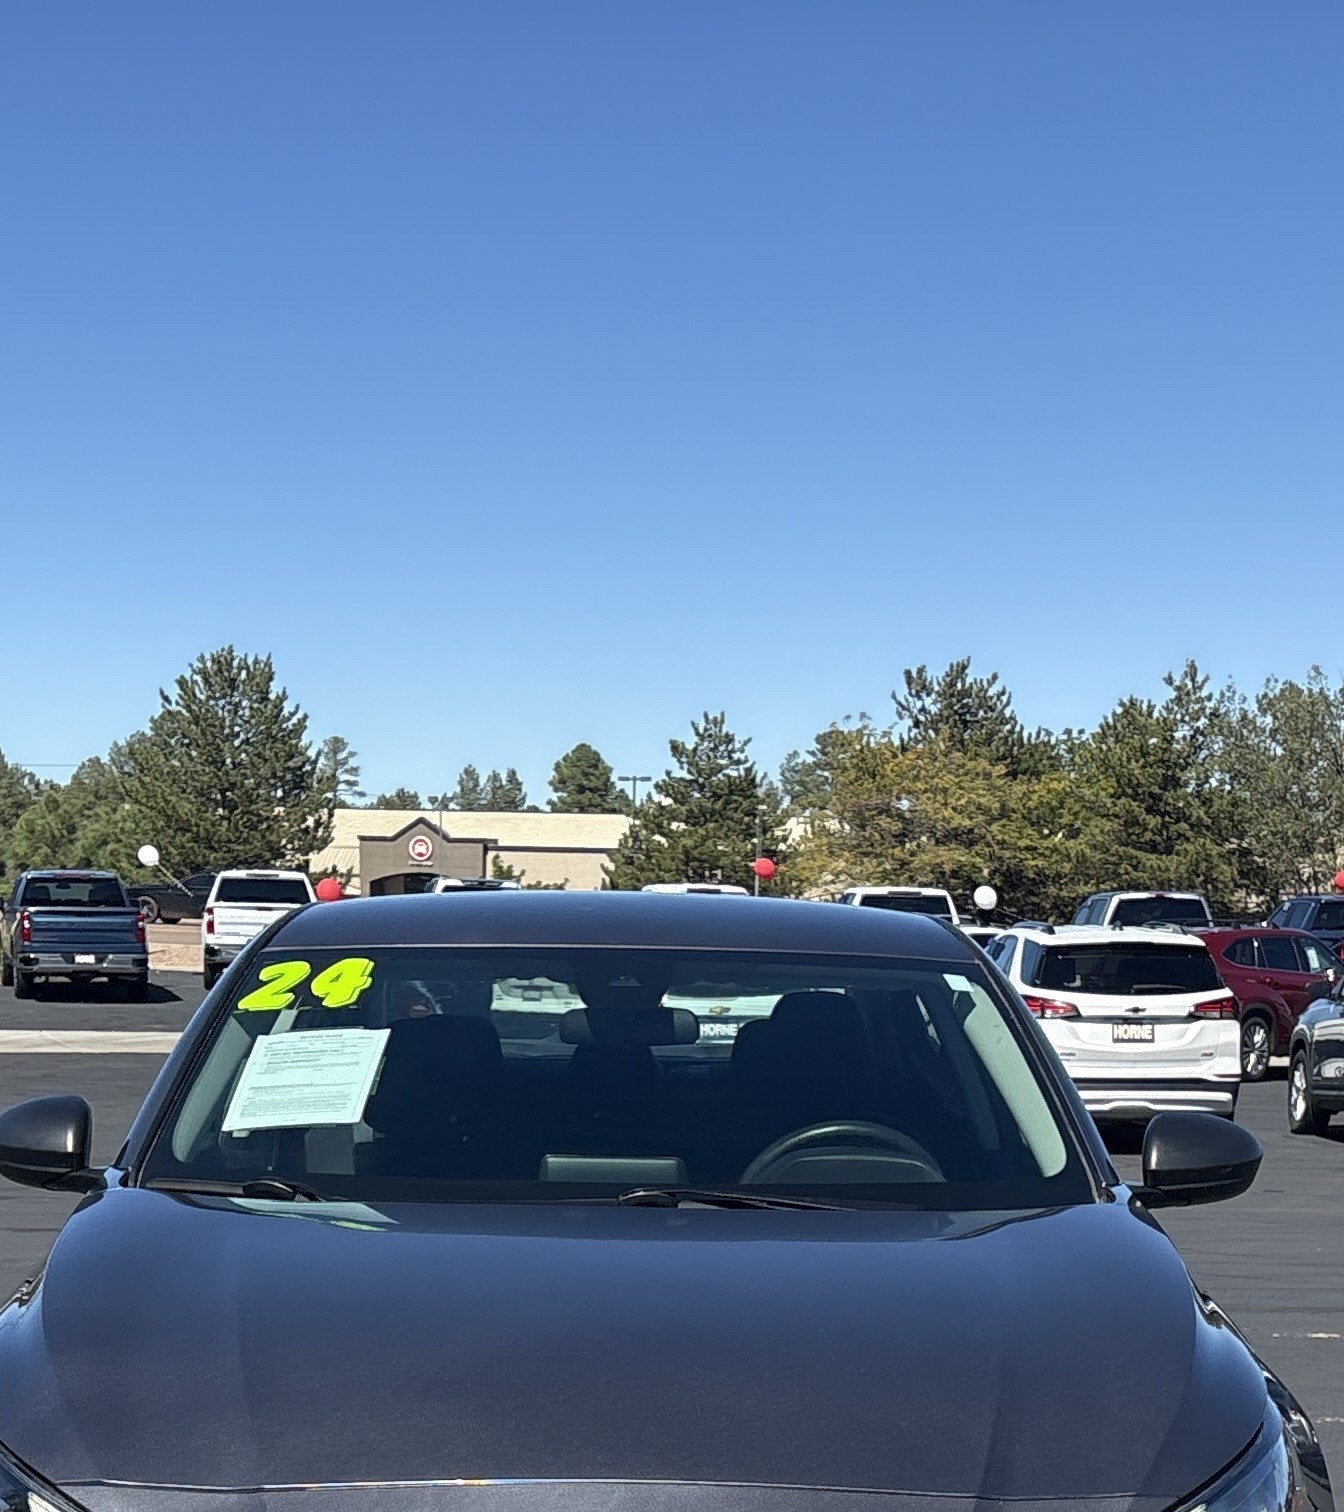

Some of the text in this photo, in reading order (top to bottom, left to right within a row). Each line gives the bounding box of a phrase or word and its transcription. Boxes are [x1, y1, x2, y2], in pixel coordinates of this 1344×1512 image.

[237, 957, 375, 1011] 24
[699, 1023, 738, 1036] HORNE
[1113, 1025, 1153, 1040] HORNE
